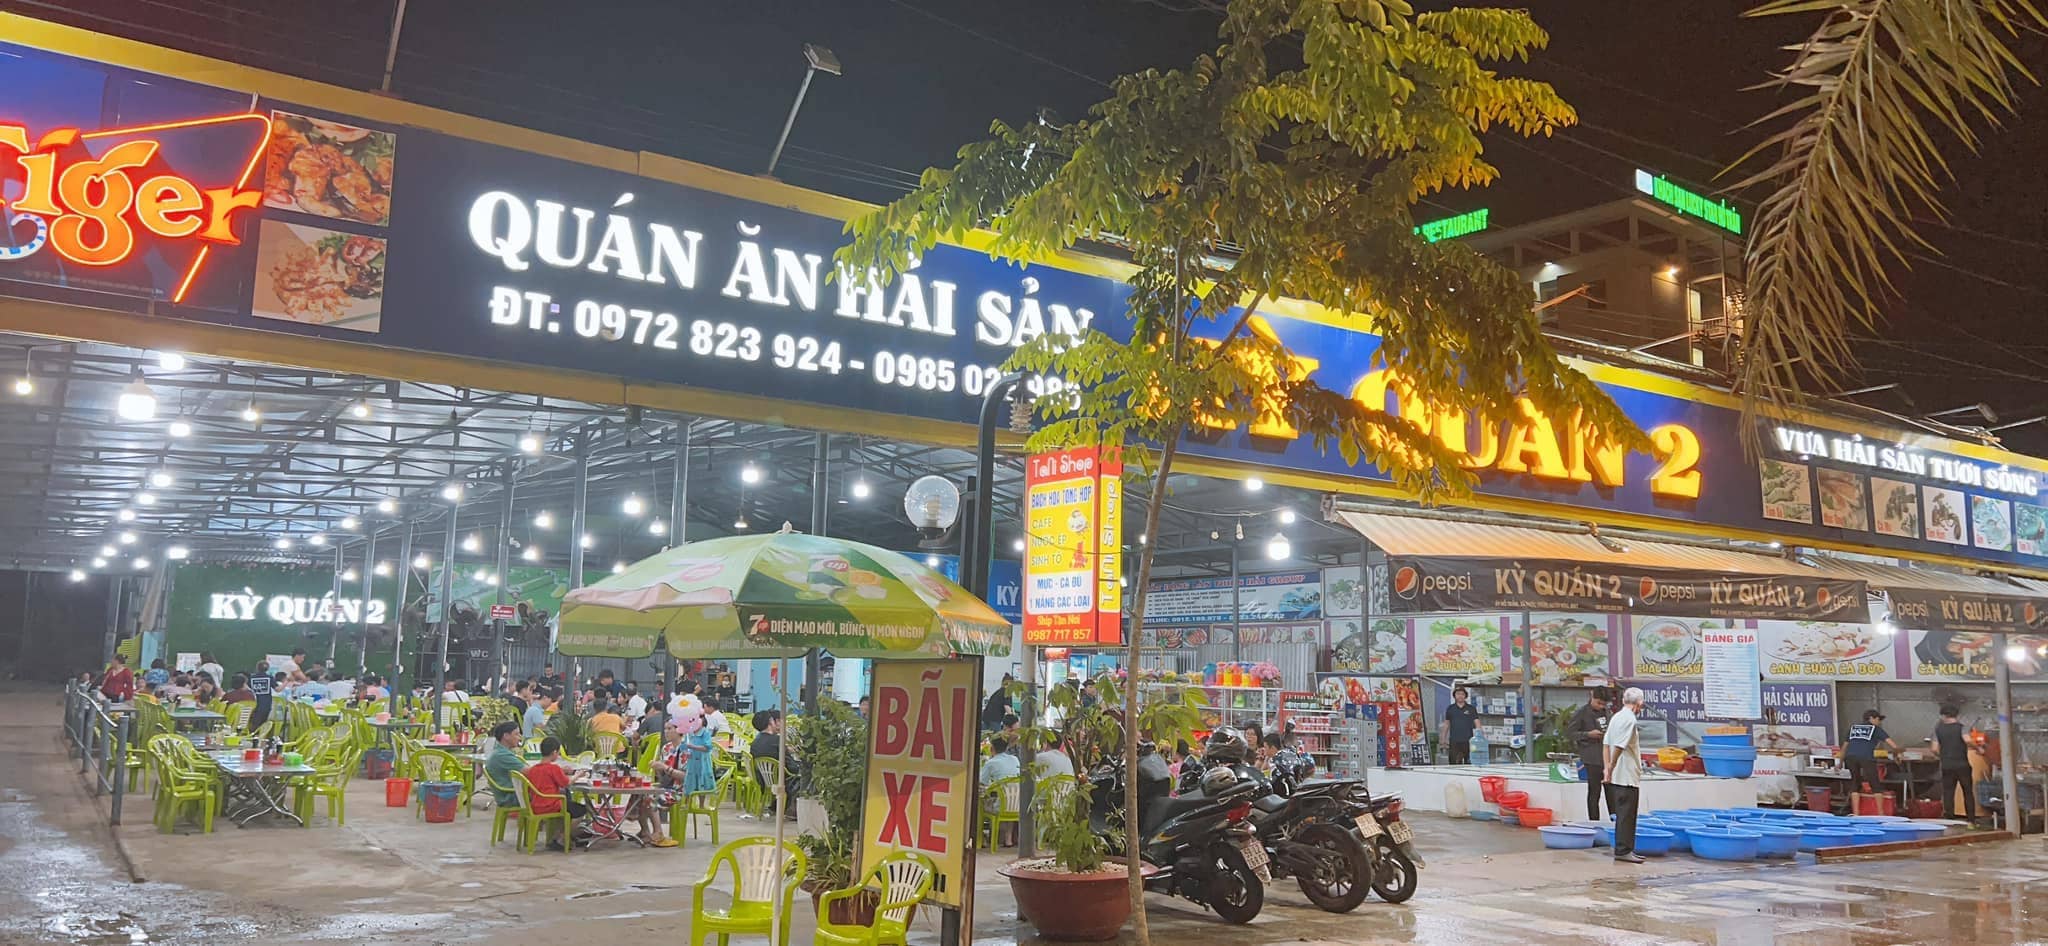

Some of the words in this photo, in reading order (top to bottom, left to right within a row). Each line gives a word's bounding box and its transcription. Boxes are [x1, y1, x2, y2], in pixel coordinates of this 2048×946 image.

[469, 192, 703, 289] QUÁN
[721, 220, 823, 311] ĂN
[975, 276, 1094, 354] SẢN
[488, 285, 560, 333] ĐT:
[573, 299, 678, 350] 0972
[690, 319, 761, 361] 823
[773, 334, 842, 375] 924
[873, 350, 955, 393] 0985
[1060, 454, 1094, 476] Shop
[1650, 423, 1702, 499] 2
[1776, 427, 1827, 460] VỰA
[1831, 433, 1876, 467] HẢI
[1880, 443, 1926, 475] SẢN
[209, 586, 262, 620] KỲ
[268, 590, 363, 625] QUÁN
[366, 599, 386, 625] 2
[1422, 572, 1472, 594] pepsi
[1495, 562, 1526, 595] KỲ
[1534, 565, 1602, 598] QUÁN
[1609, 575, 1622, 599] 2
[1660, 582, 1697, 601] pepsi
[1739, 576, 1791, 607] QUÁN
[1794, 585, 1806, 609] 2
[1963, 598, 2002, 622] QUÁN
[2004, 603, 2014, 623] 2
[1027, 629, 1052, 641] 0987
[1054, 629, 1070, 640] 717
[1072, 628, 1091, 640] 857
[1769, 662, 1800, 674] CANH
[874, 669, 967, 762] BÃI
[1643, 689, 1659, 704] UNG
[1660, 685, 1678, 704] CẤP
[1691, 690, 1699, 704] &
[1763, 686, 1781, 706] HẢI
[1783, 686, 1803, 707] SẢN
[1806, 688, 1828, 707] KHÔ
[1790, 711, 1811, 723] KHÔ
[877, 771, 950, 854] XE
